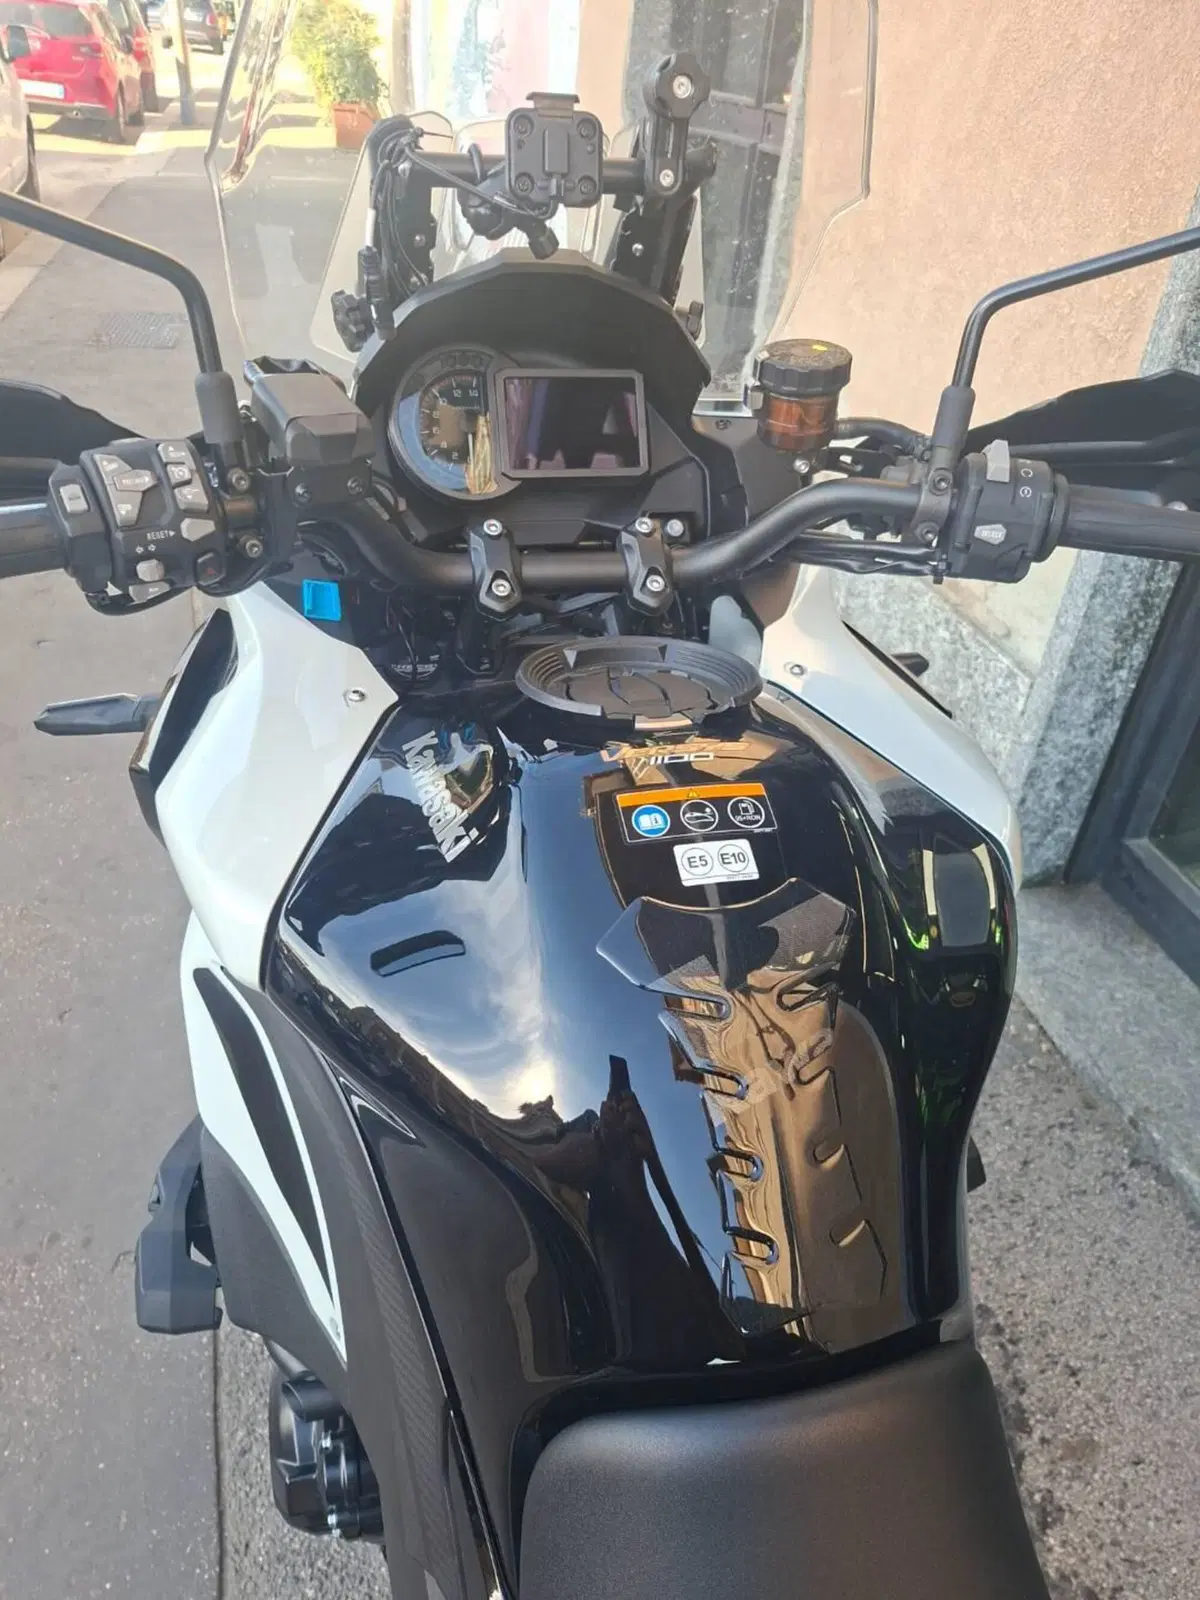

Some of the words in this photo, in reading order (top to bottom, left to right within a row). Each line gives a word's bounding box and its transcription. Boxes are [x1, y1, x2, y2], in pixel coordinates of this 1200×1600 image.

[146, 530, 169, 541] RESET
[402, 729, 480, 863] Kawasaki
[686, 855, 709, 869] E5
[719, 851, 747, 866] E10
